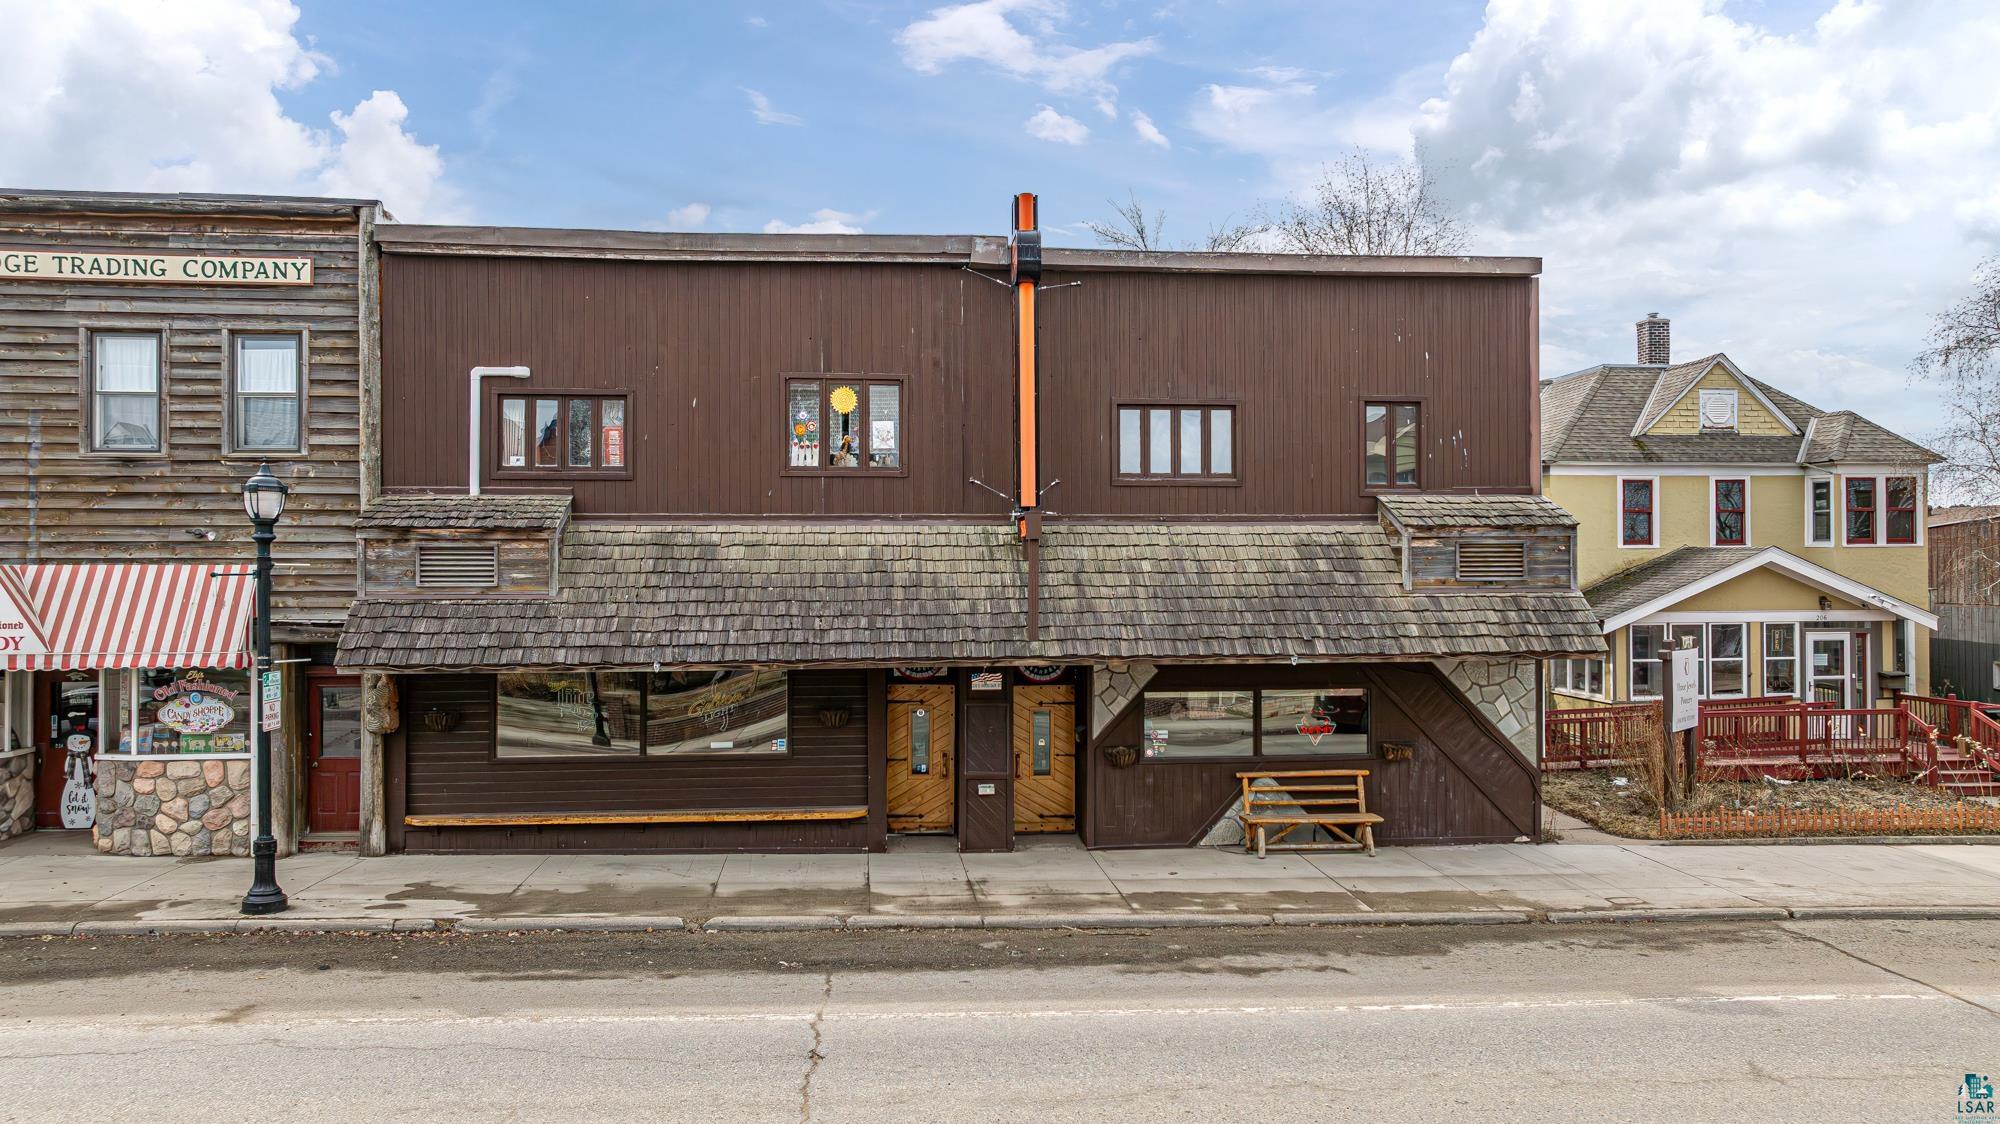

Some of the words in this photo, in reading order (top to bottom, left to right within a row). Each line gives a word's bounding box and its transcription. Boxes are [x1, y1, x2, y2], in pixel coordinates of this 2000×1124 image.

[0, 254, 39, 273] GE
[52, 256, 168, 277] TRADING
[182, 259, 308, 280] COMPANY
[153, 681, 178, 701] Old
[177, 678, 240, 701] Fashioned
[167, 708, 191, 721] CANDY
[192, 705, 225, 718] SHOPPE
[81, 792, 89, 804] it
[66, 804, 92, 815] snow
